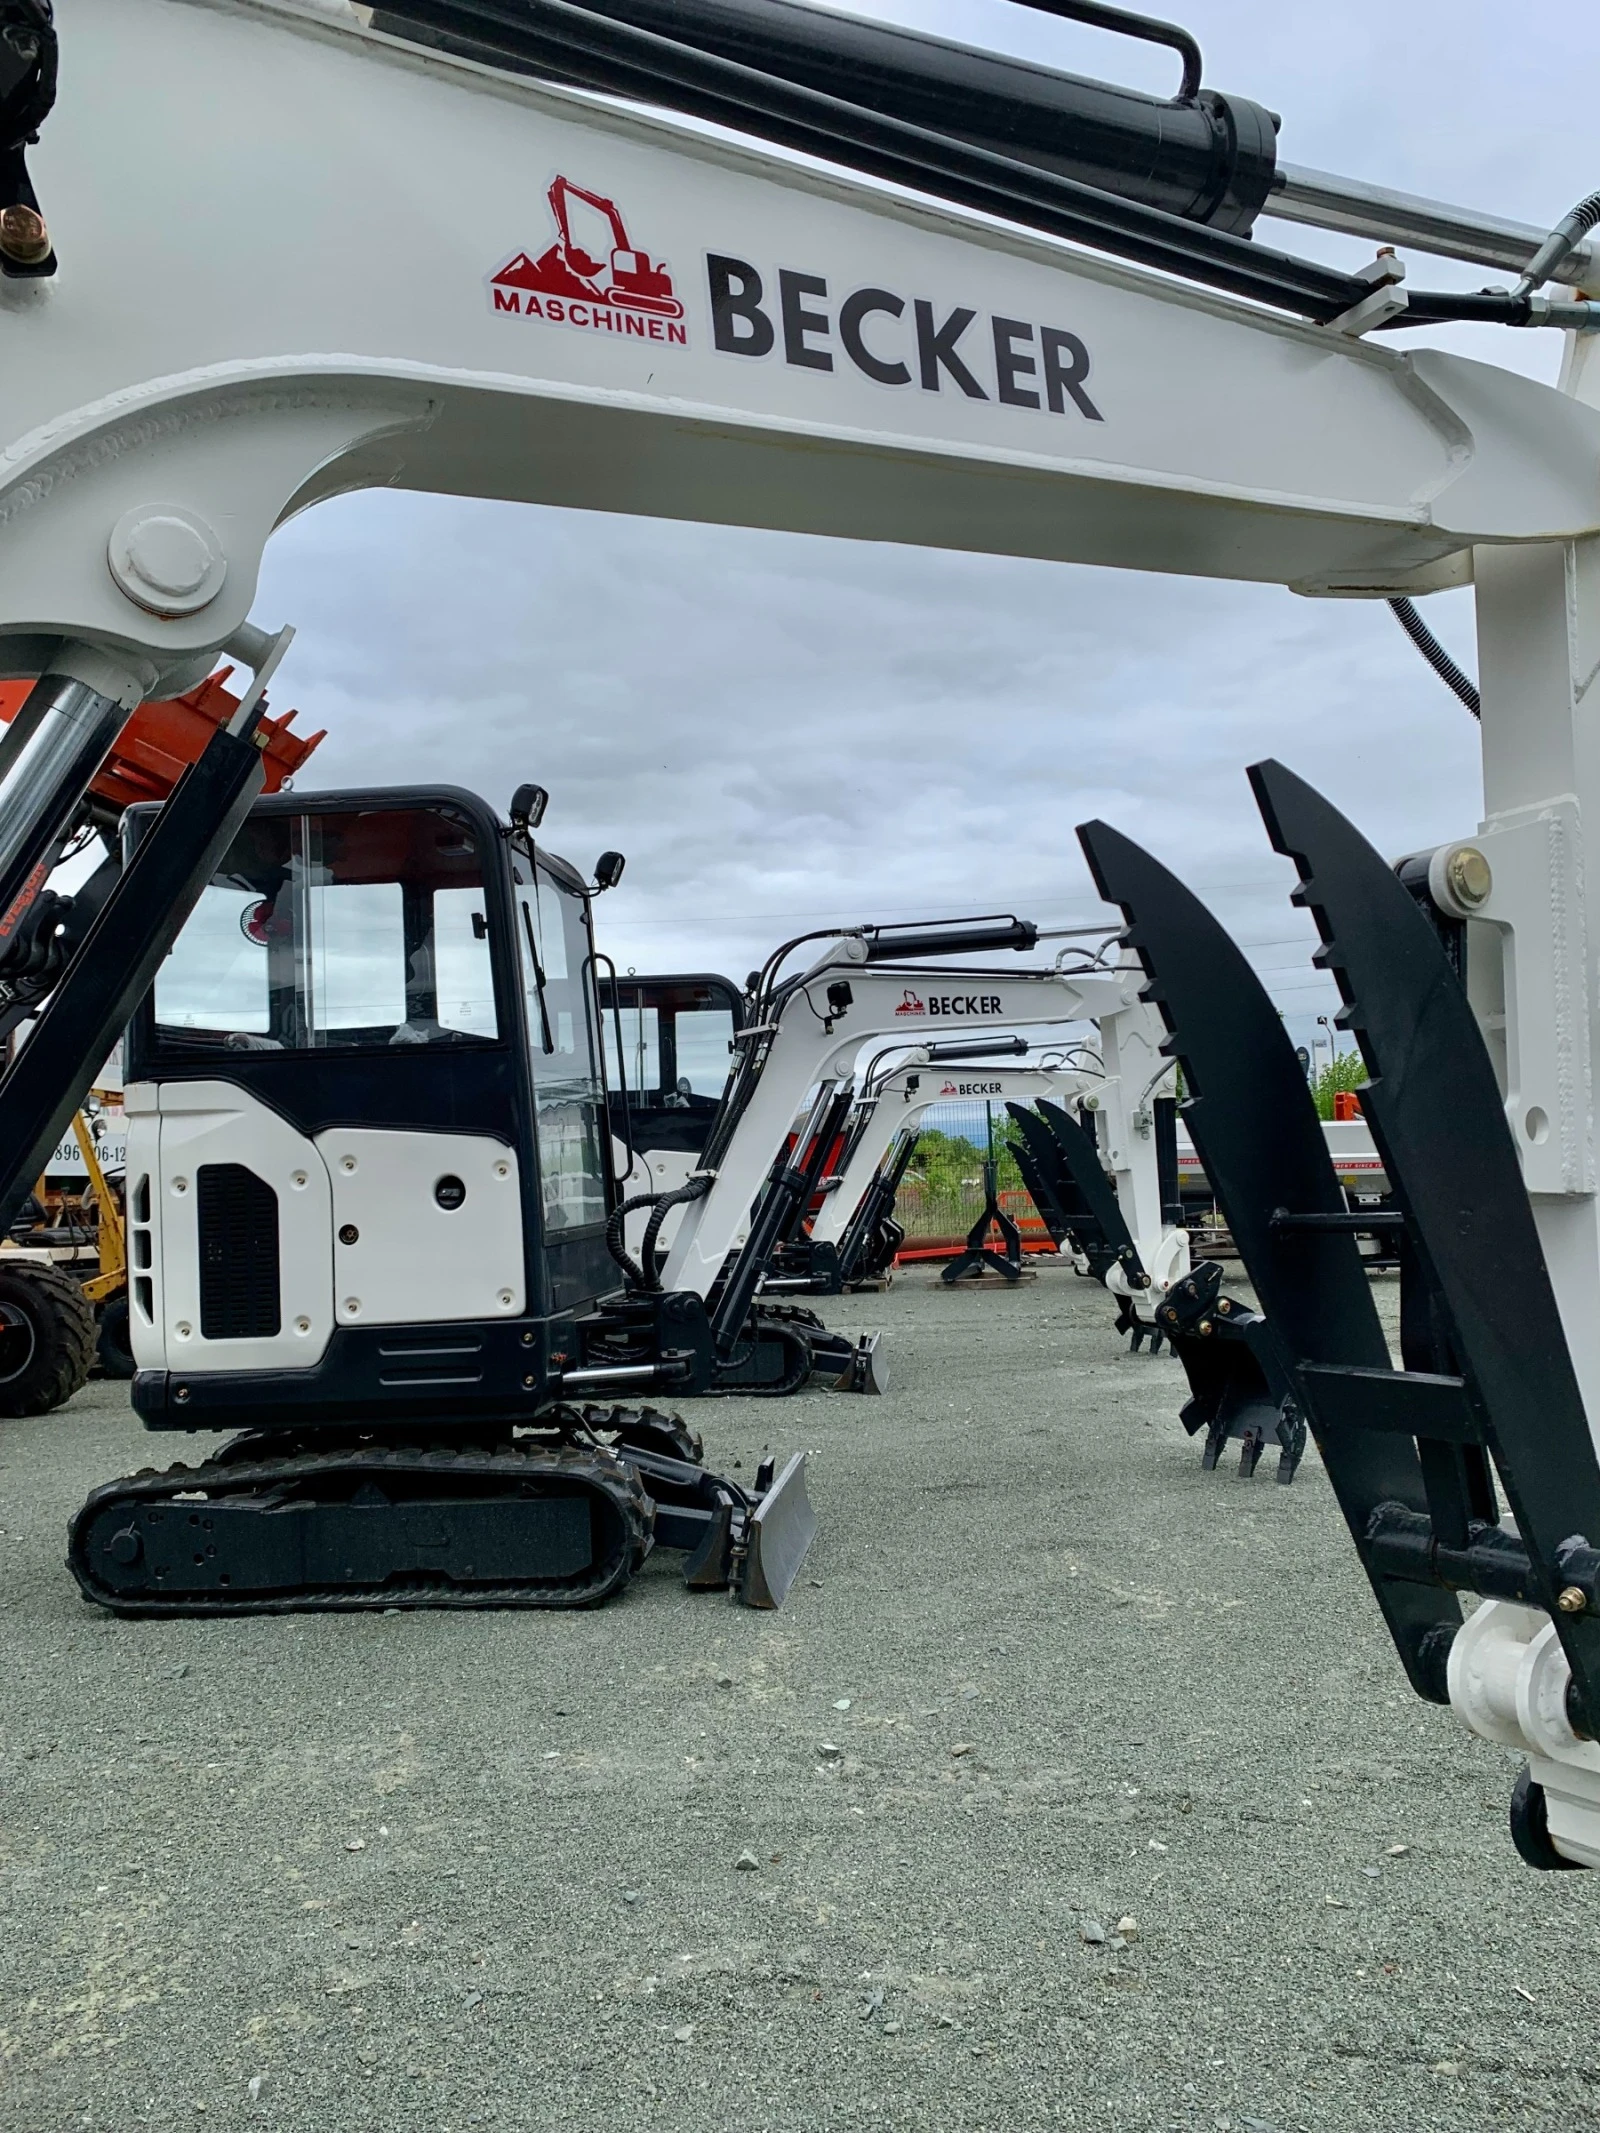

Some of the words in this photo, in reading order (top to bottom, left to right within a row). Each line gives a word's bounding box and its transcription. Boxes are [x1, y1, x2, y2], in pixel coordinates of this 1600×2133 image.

[493, 288, 687, 345] MASCHINEN
[706, 253, 1105, 422] BECKER
[929, 996, 1003, 1015] BECKER
[959, 1082, 1002, 1095] BECKER
